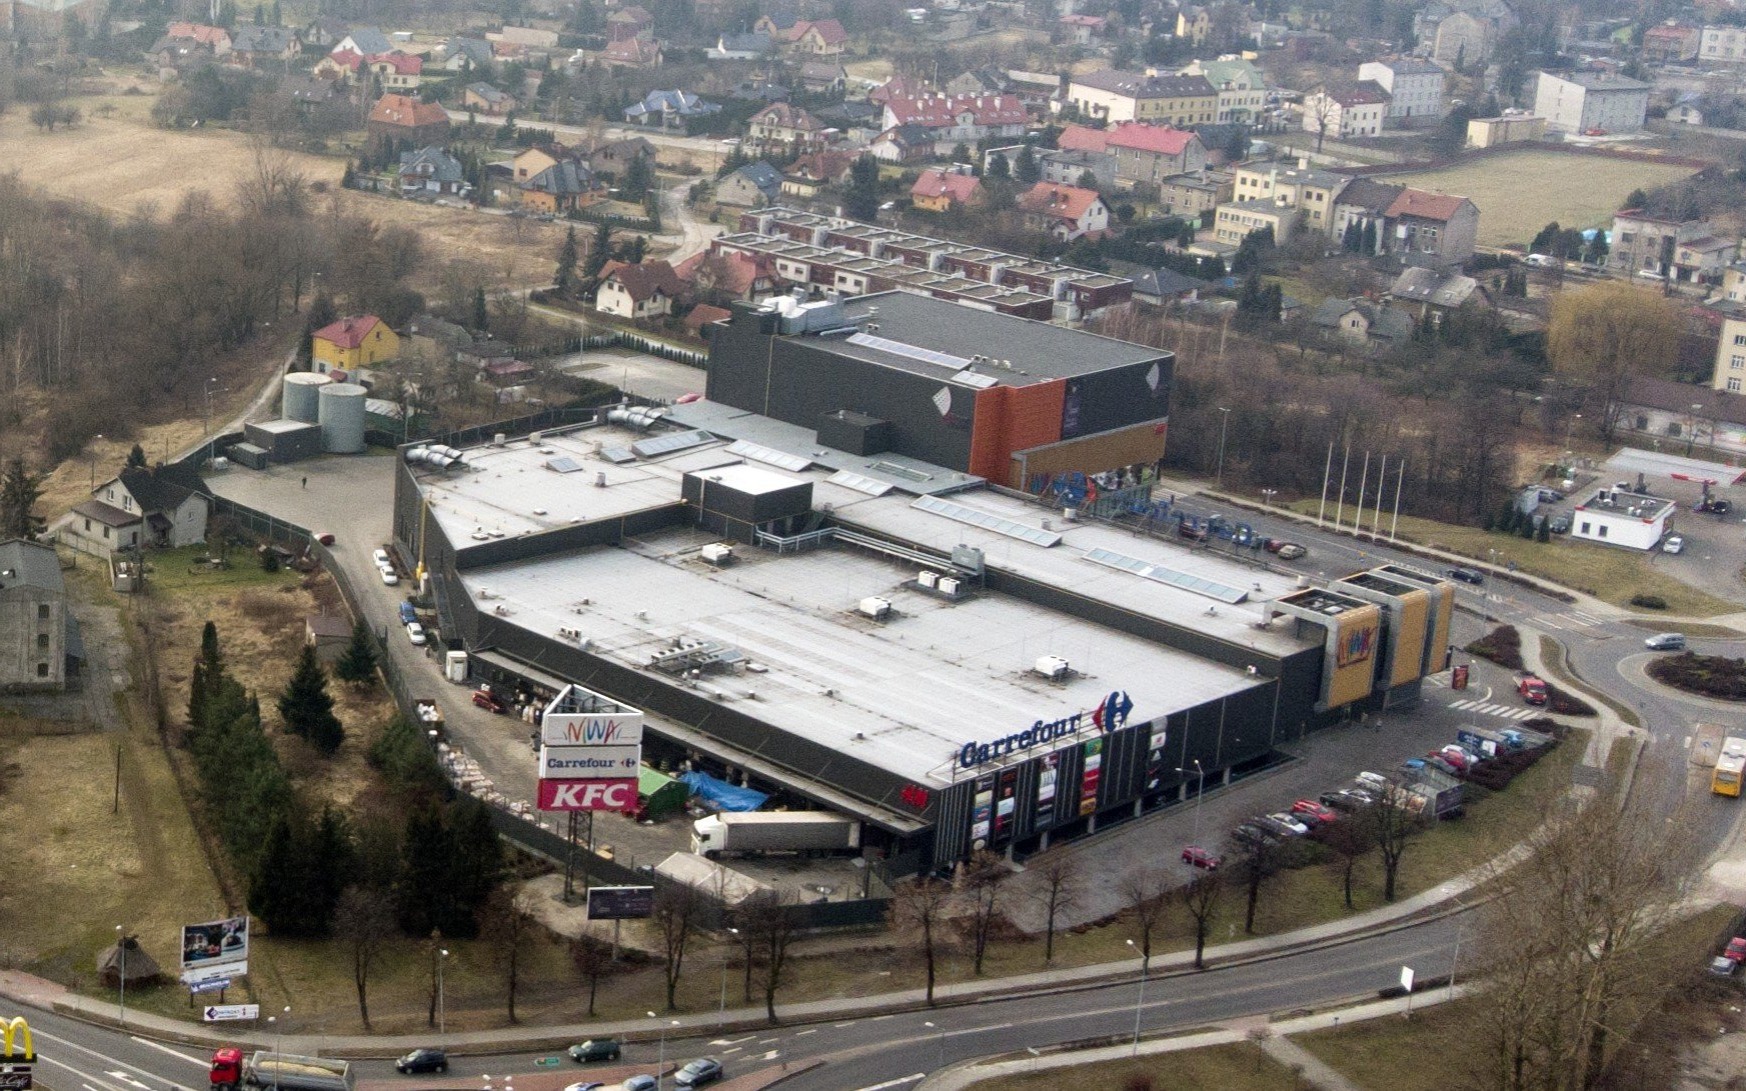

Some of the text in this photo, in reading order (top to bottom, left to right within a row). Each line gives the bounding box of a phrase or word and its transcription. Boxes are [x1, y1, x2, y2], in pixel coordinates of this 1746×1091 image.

[960, 713, 1082, 769] Carrefour
[547, 758, 616, 769] Carrefour
[551, 784, 629, 807] KFC
